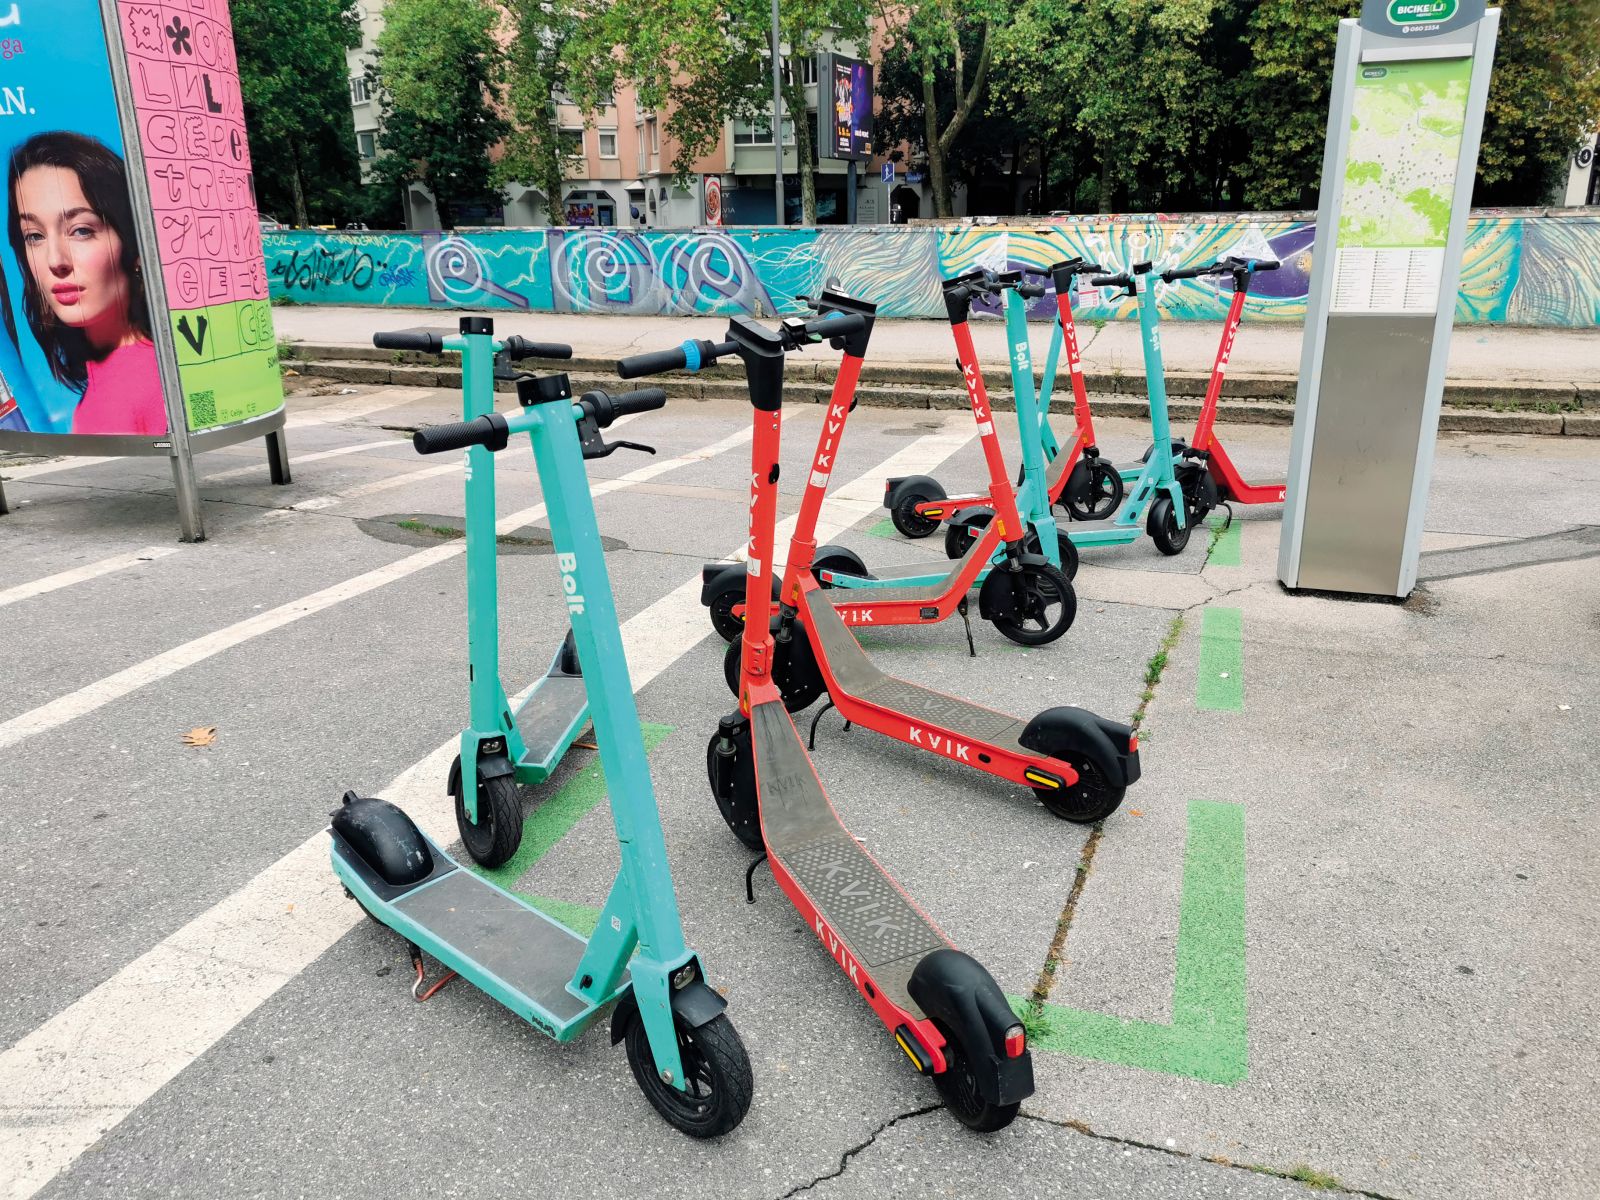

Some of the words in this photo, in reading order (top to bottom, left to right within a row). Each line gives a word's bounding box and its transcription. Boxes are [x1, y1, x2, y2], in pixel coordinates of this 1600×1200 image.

[0, 38, 24, 60] ga
[1014, 341, 1028, 371] Bolt
[1066, 322, 1079, 360] KVIK
[1150, 325, 1160, 351] Bolt
[1222, 320, 1238, 361] KVIK
[963, 363, 986, 418] KVIK
[817, 403, 845, 468] KVIK
[464, 446, 473, 482] olt
[557, 552, 585, 616] Bolt
[909, 726, 970, 761] KVIK
[818, 859, 901, 939] KVIK
[815, 914, 860, 985] KVIK
